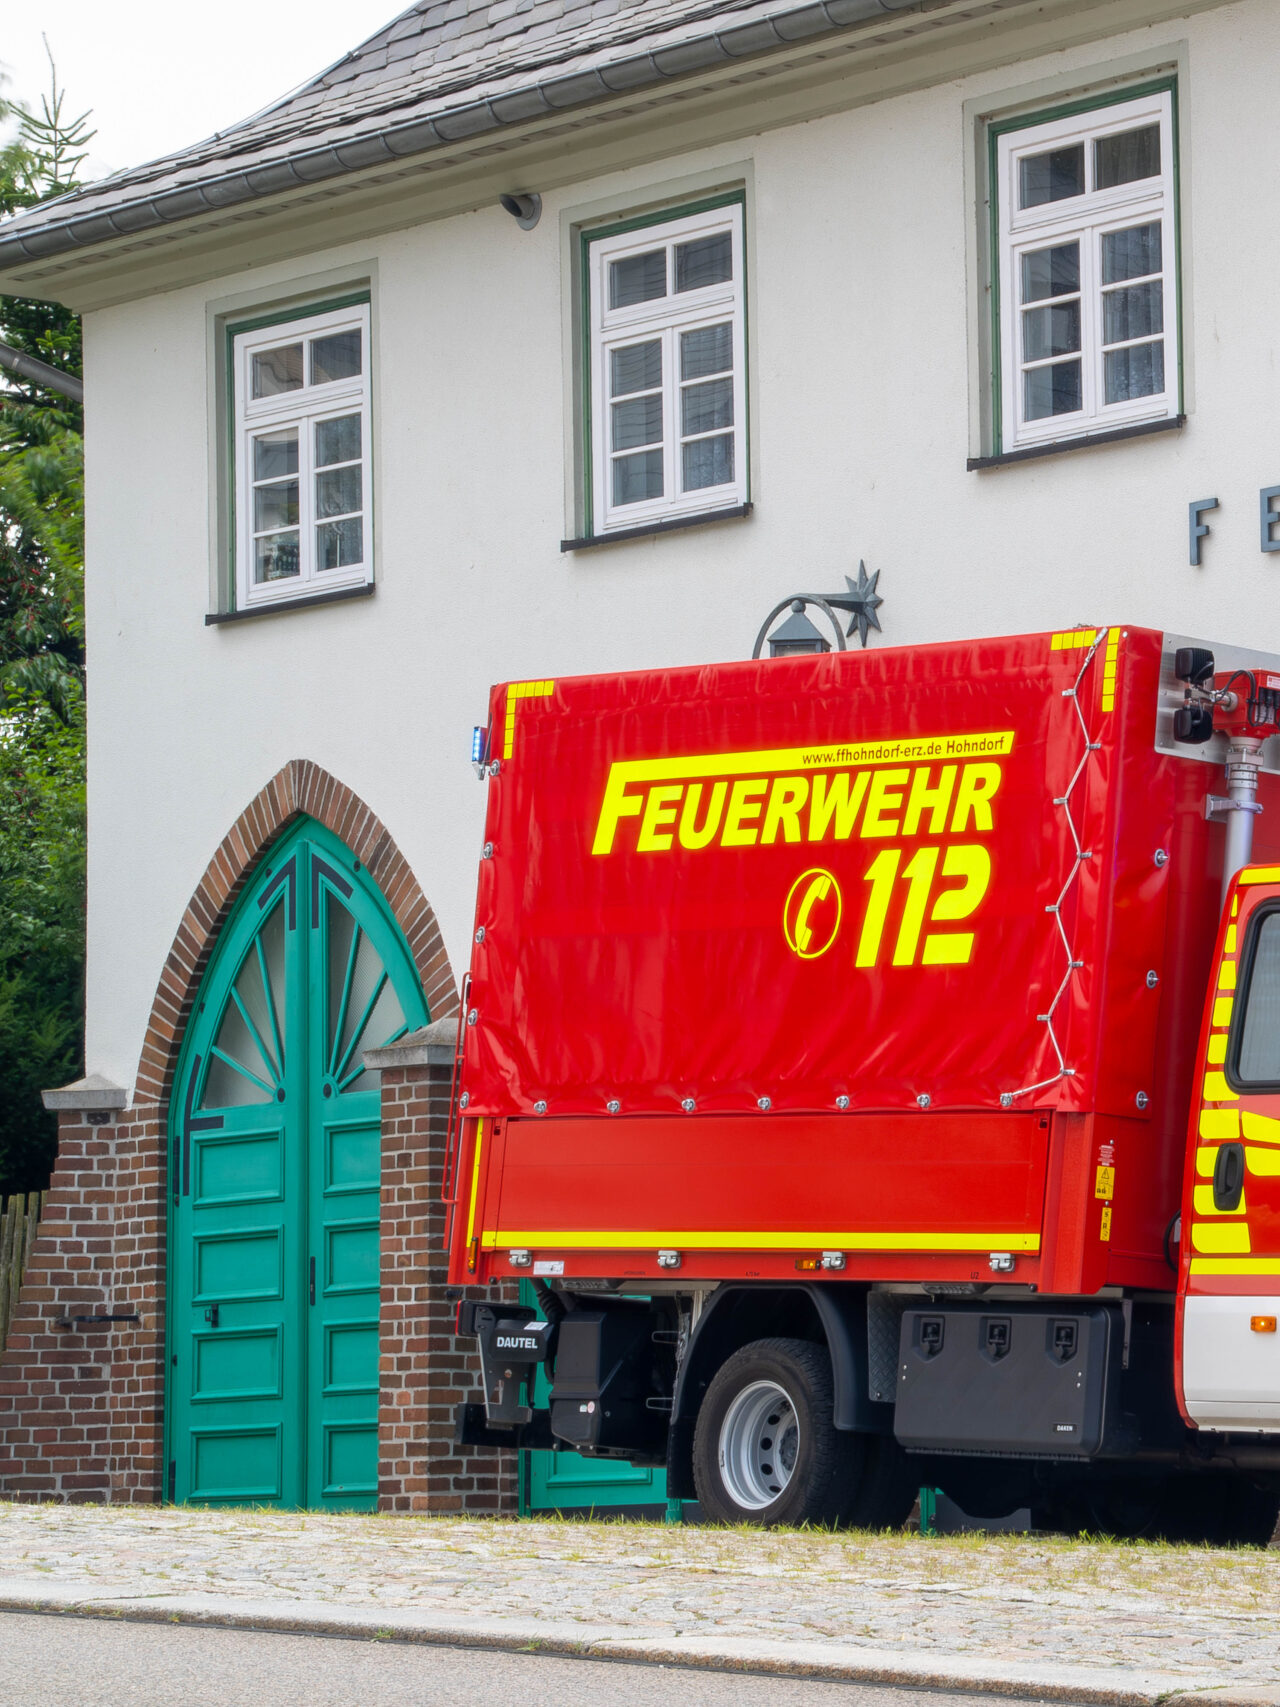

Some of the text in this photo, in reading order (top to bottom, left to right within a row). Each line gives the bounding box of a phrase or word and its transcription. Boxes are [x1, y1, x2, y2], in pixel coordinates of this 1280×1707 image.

[802, 736, 1005, 765] www.ffhohndorf-erz.de Hohndorf
[591, 760, 1002, 856] FEUERWEHR
[855, 844, 992, 968] 112
[496, 1336, 539, 1349] DAUTEL
